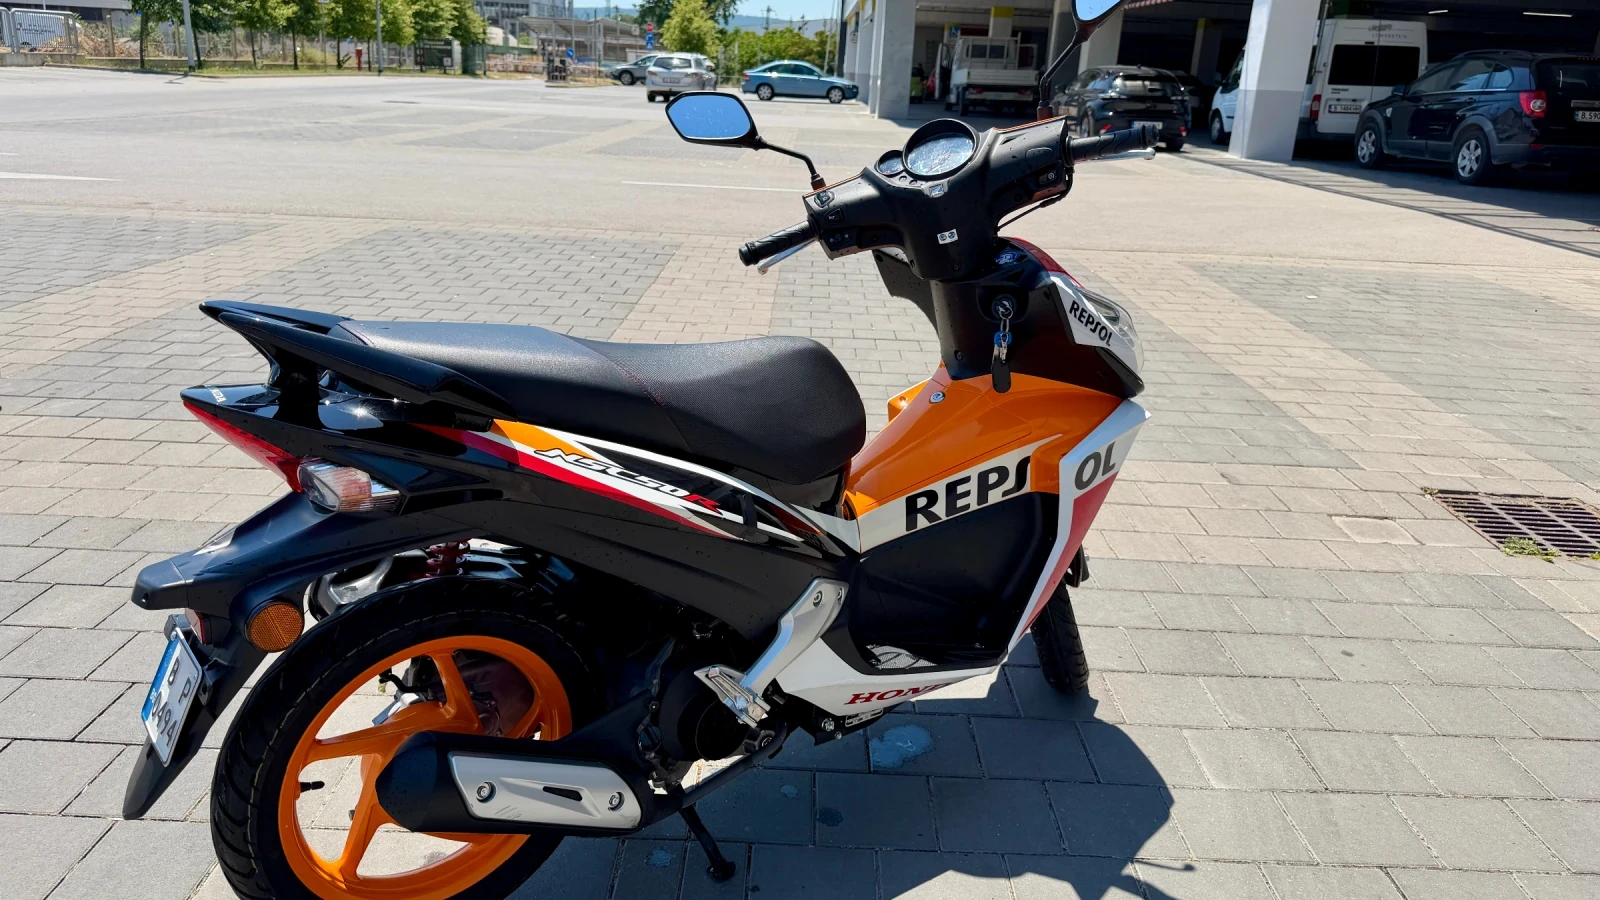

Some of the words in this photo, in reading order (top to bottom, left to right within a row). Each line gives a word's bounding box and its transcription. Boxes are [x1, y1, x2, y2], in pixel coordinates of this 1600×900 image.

[1069, 300, 1113, 347] REPSOL
[533, 447, 724, 515] NSC50R
[167, 657, 180, 686] B
[178, 677, 191, 704] P
